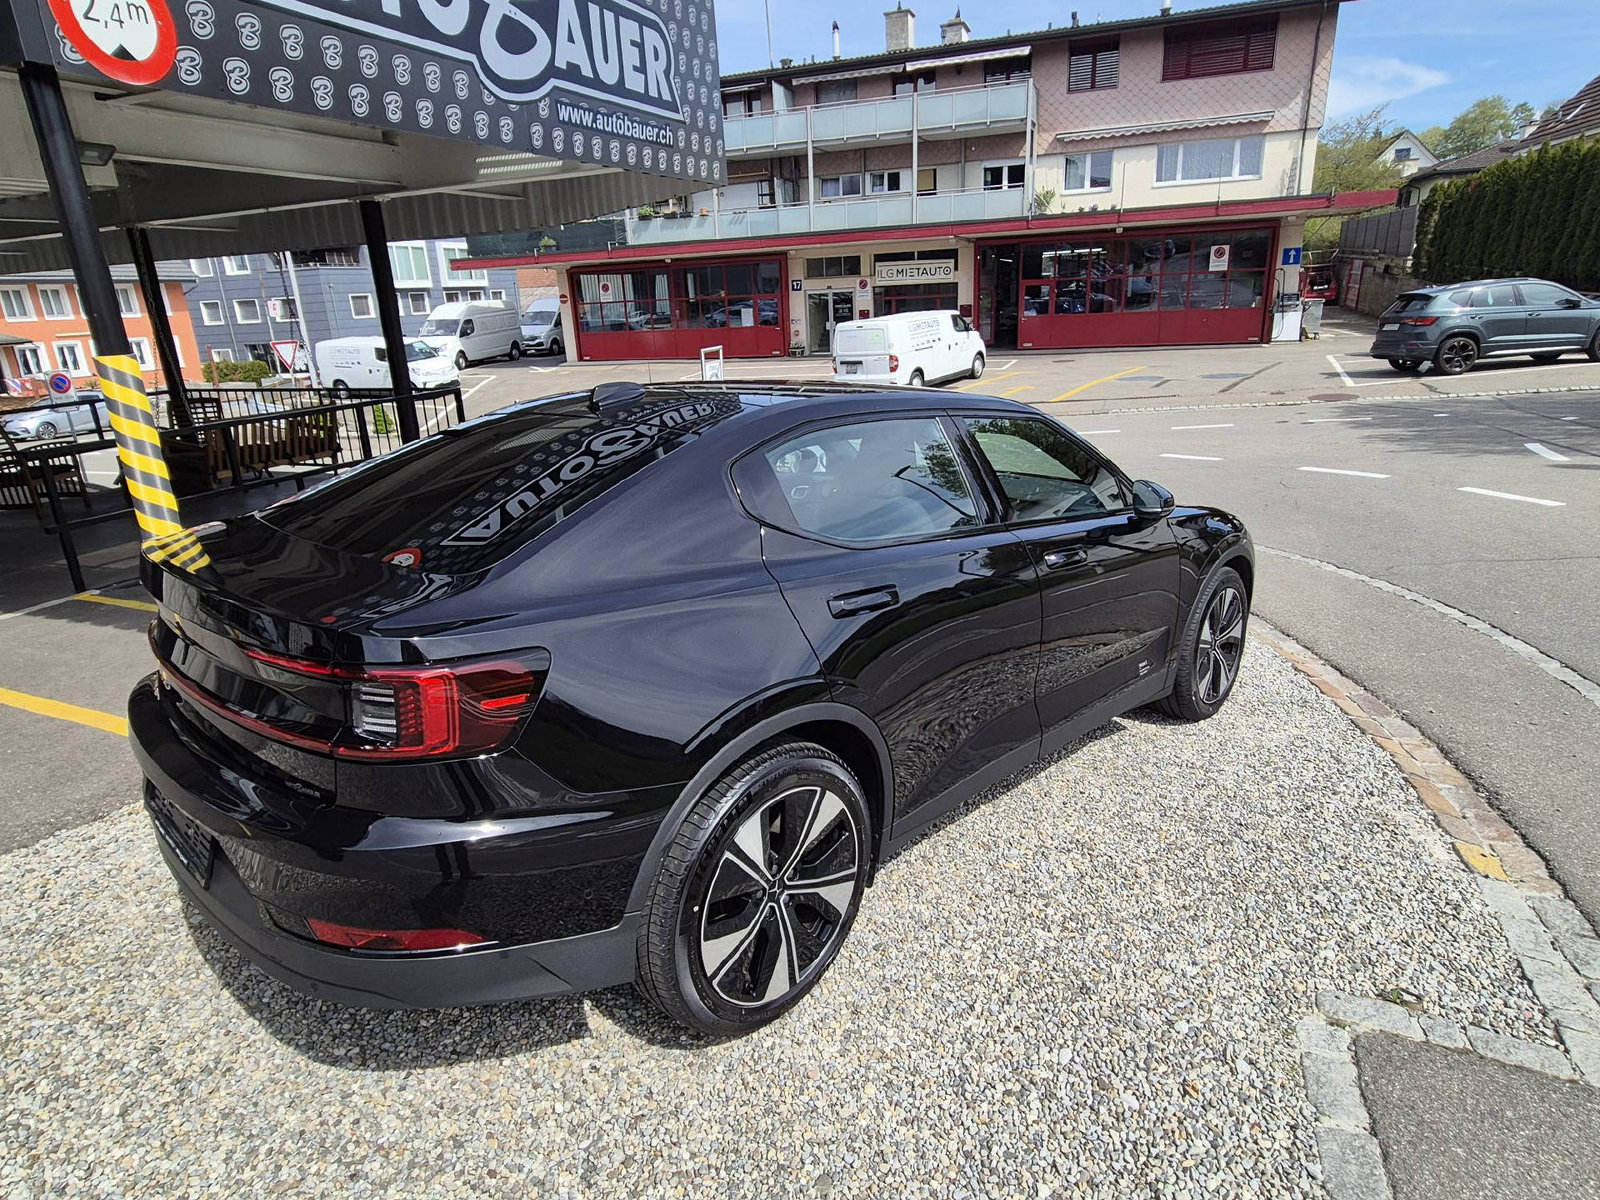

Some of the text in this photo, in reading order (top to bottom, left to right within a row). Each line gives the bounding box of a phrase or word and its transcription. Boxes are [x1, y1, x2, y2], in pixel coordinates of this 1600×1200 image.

[557, 103, 674, 146] www.autobauer.ch
[877, 266, 952, 279] ILG MIETAUTO
[792, 281, 801, 290] 17
